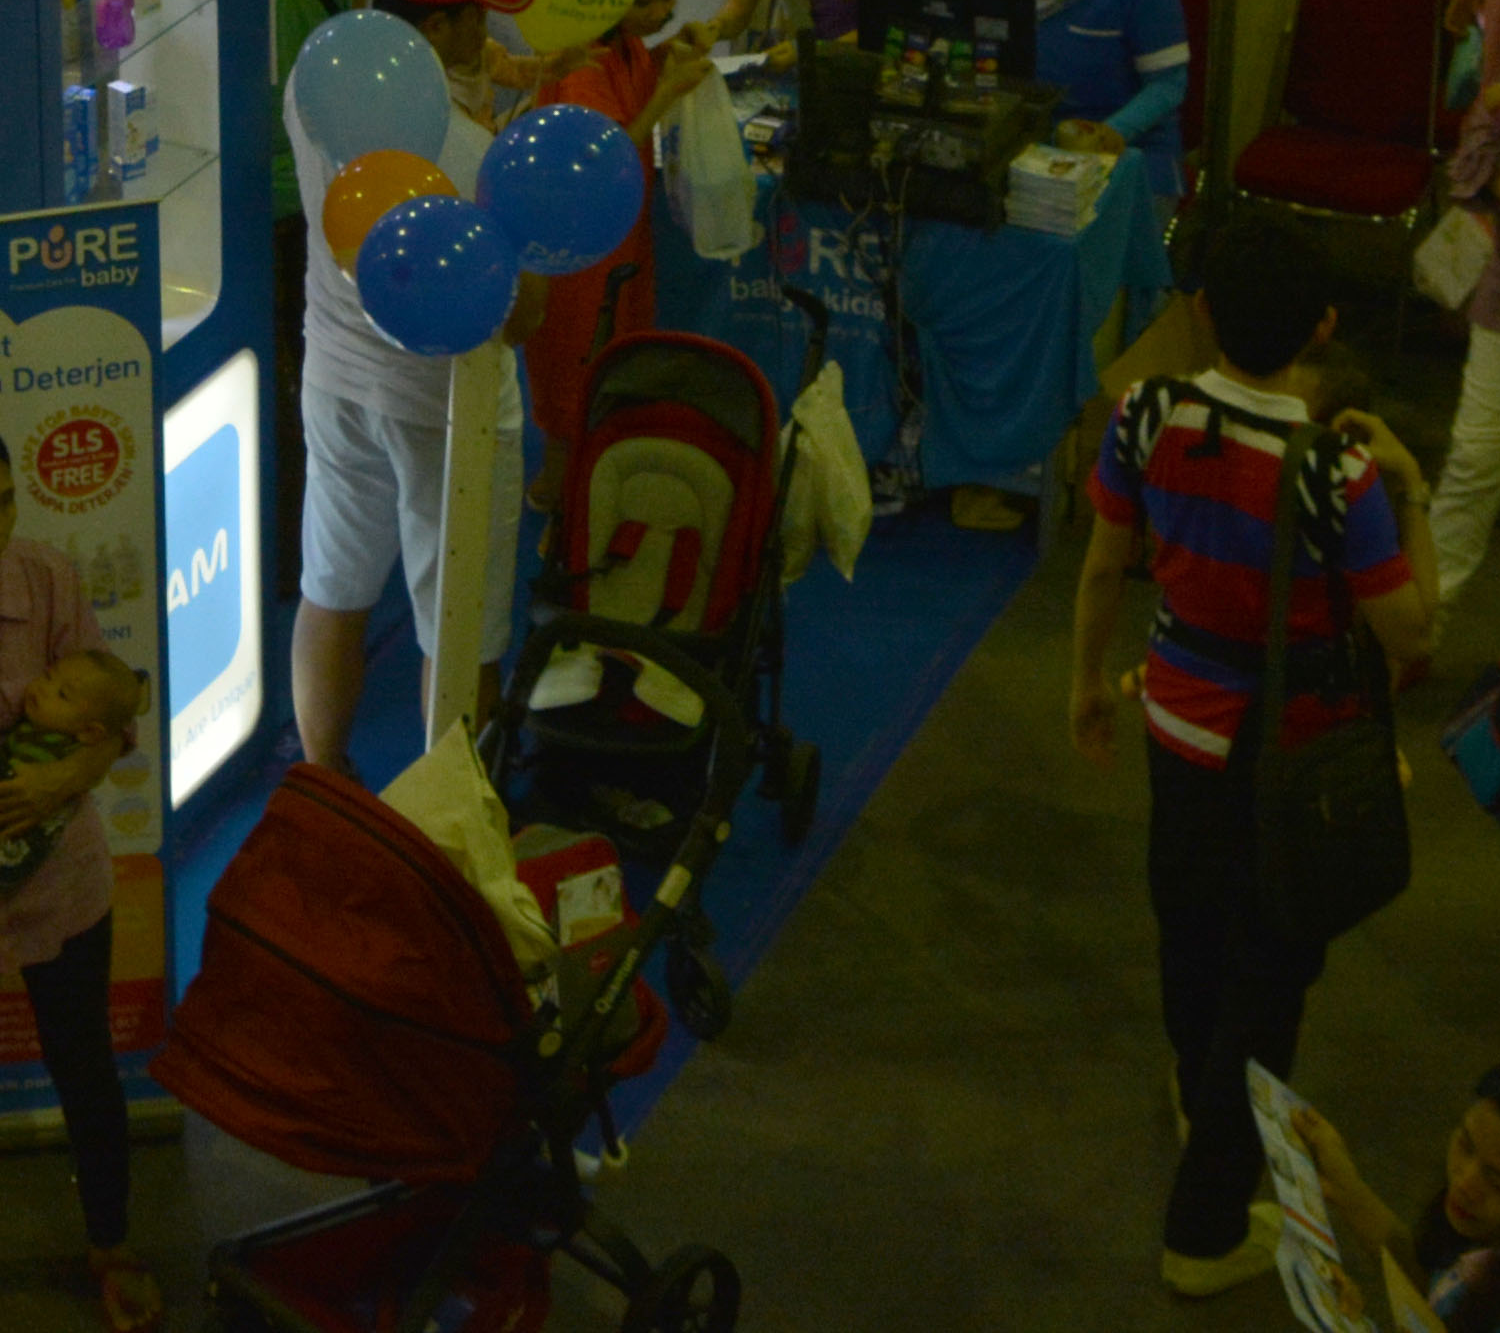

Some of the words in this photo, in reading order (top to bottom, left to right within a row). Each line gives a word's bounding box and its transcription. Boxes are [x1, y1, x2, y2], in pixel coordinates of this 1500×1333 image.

[9, 223, 139, 276] PURE
[80, 264, 139, 290] baby
[14, 357, 141, 395] Deterjen
[52, 428, 105, 459] SLS
[50, 462, 105, 490] FREE
